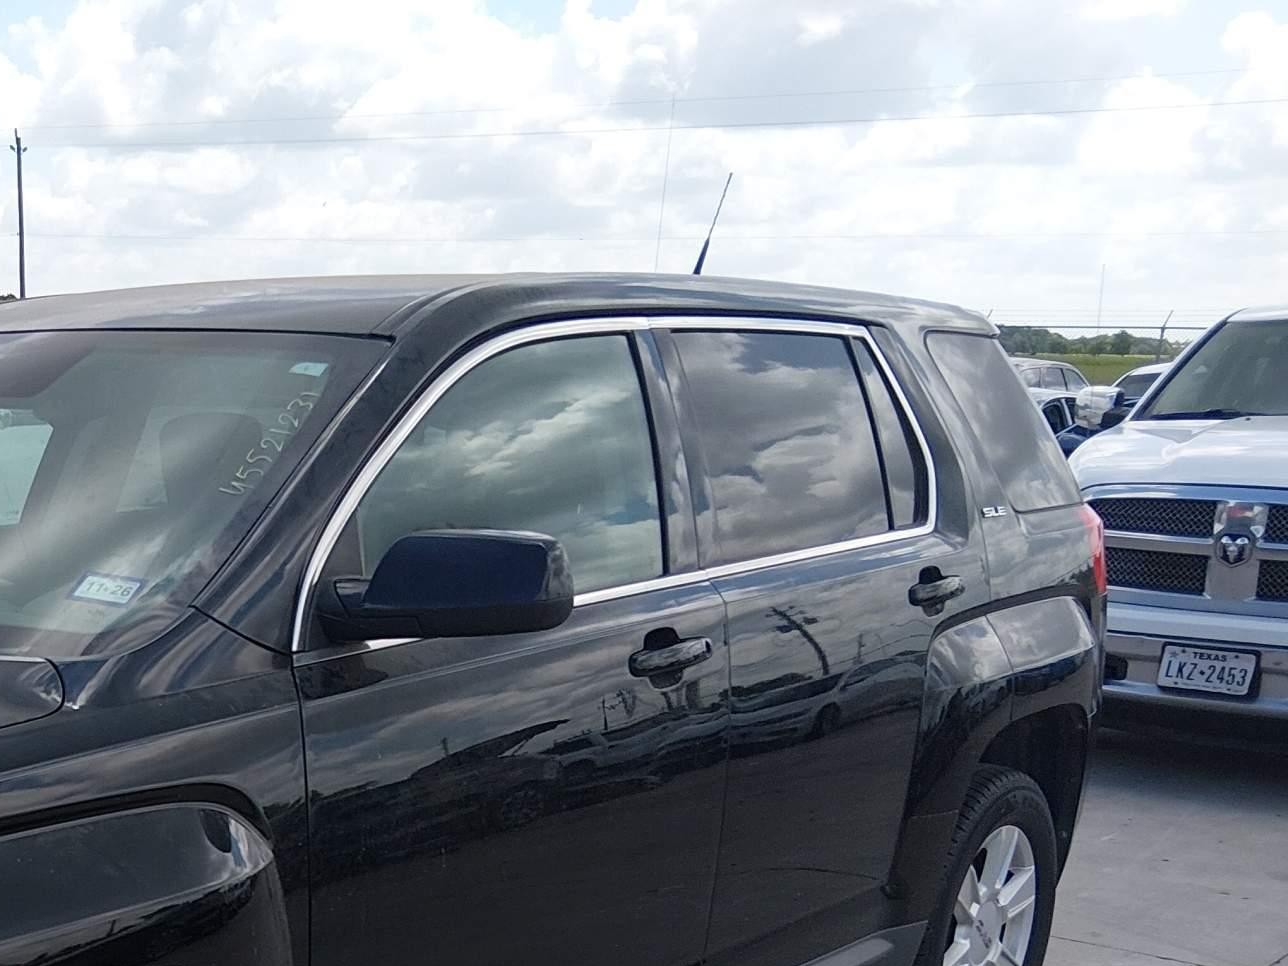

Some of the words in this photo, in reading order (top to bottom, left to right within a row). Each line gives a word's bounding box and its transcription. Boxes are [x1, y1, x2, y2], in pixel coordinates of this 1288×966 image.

[219, 391, 321, 495] 45521231
[982, 506, 1007, 518] SLE
[1192, 651, 1227, 662] TEXAS
